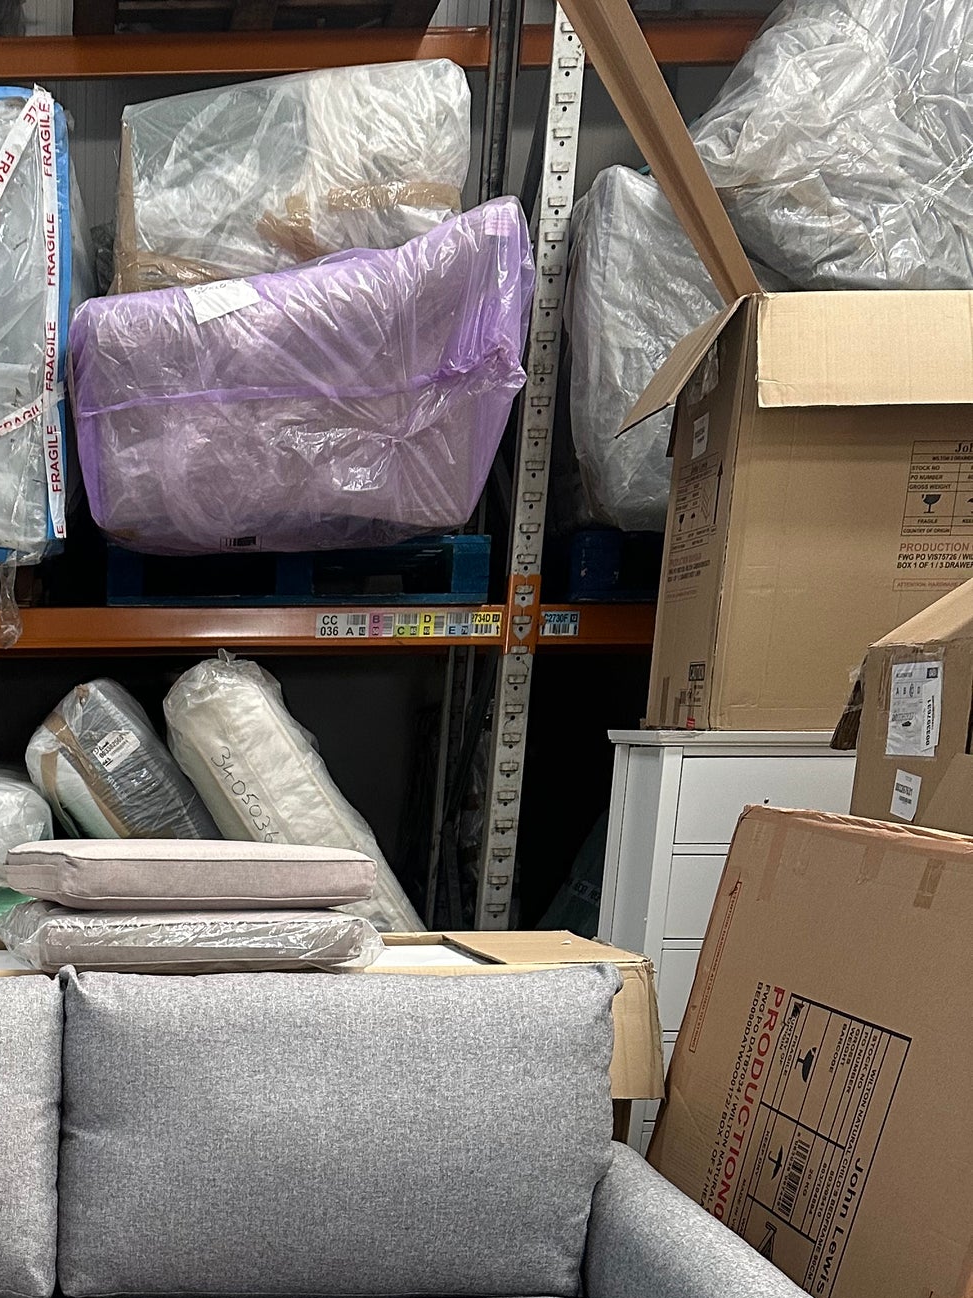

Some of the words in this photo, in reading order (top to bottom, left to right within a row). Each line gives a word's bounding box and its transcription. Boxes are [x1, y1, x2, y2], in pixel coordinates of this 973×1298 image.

[38, 102, 53, 177] FRAGILE
[46, 212, 56, 287] FRAGILE
[45, 321, 57, 392] FRAGILE
[46, 425, 62, 493] FRAGILE
[900, 543, 970, 552] PRODUCTION
[320, 626, 339, 636] 036
[346, 627, 354, 636] A
[322, 615, 338, 625] CC
[373, 615, 380, 623] B
[397, 626, 405, 635] C
[424, 615, 432, 623] D
[449, 625, 456, 634] E
[757, 983, 771, 1013] FWG
[752, 1014, 762, 1034] PO
[860, 1030, 869, 1047] PO
[782, 1034, 798, 1077] FRAGILE
[828, 1022, 847, 1074] BARCODE
[839, 1025, 856, 1066] WEIGHT
[861, 1033, 878, 1072] STOCK
[845, 1047, 863, 1094] NUMBER
[856, 1072, 865, 1090] NO
[860, 1067, 877, 1108] WILTON
[716, 1110, 727, 1137] BOX
[721, 1101, 737, 1148] WILTON
[845, 1108, 864, 1156] NATURAL
[706, 1149, 725, 1205] NATURAL
[709, 1148, 718, 1166] OF
[838, 1156, 866, 1220] John
[814, 1225, 844, 1295] Lewis
